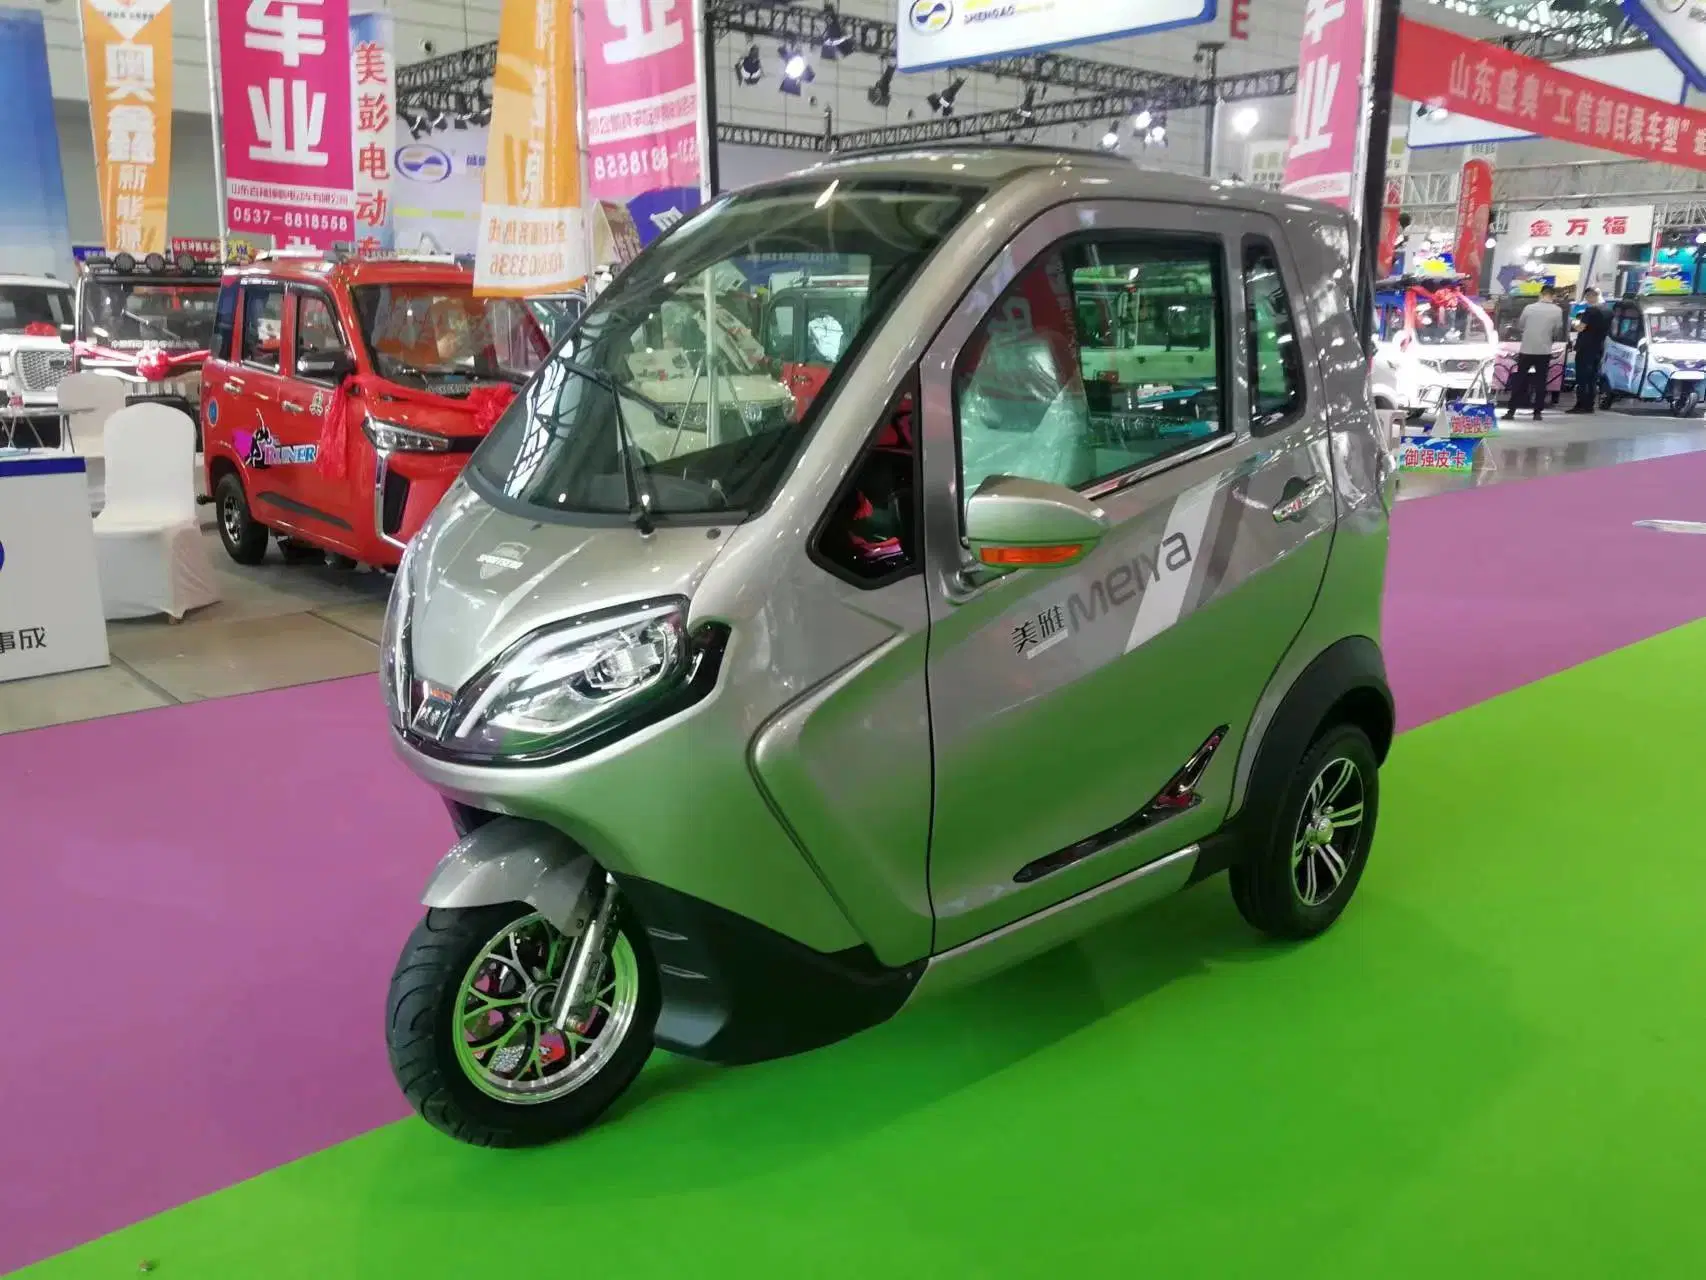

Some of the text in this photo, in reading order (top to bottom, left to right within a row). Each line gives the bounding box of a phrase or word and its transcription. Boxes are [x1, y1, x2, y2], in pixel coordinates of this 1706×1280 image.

[1529, 215, 1630, 238] 金万福
[1405, 448, 1466, 468] 御强皮卡
[1010, 604, 1067, 654] 美雅
